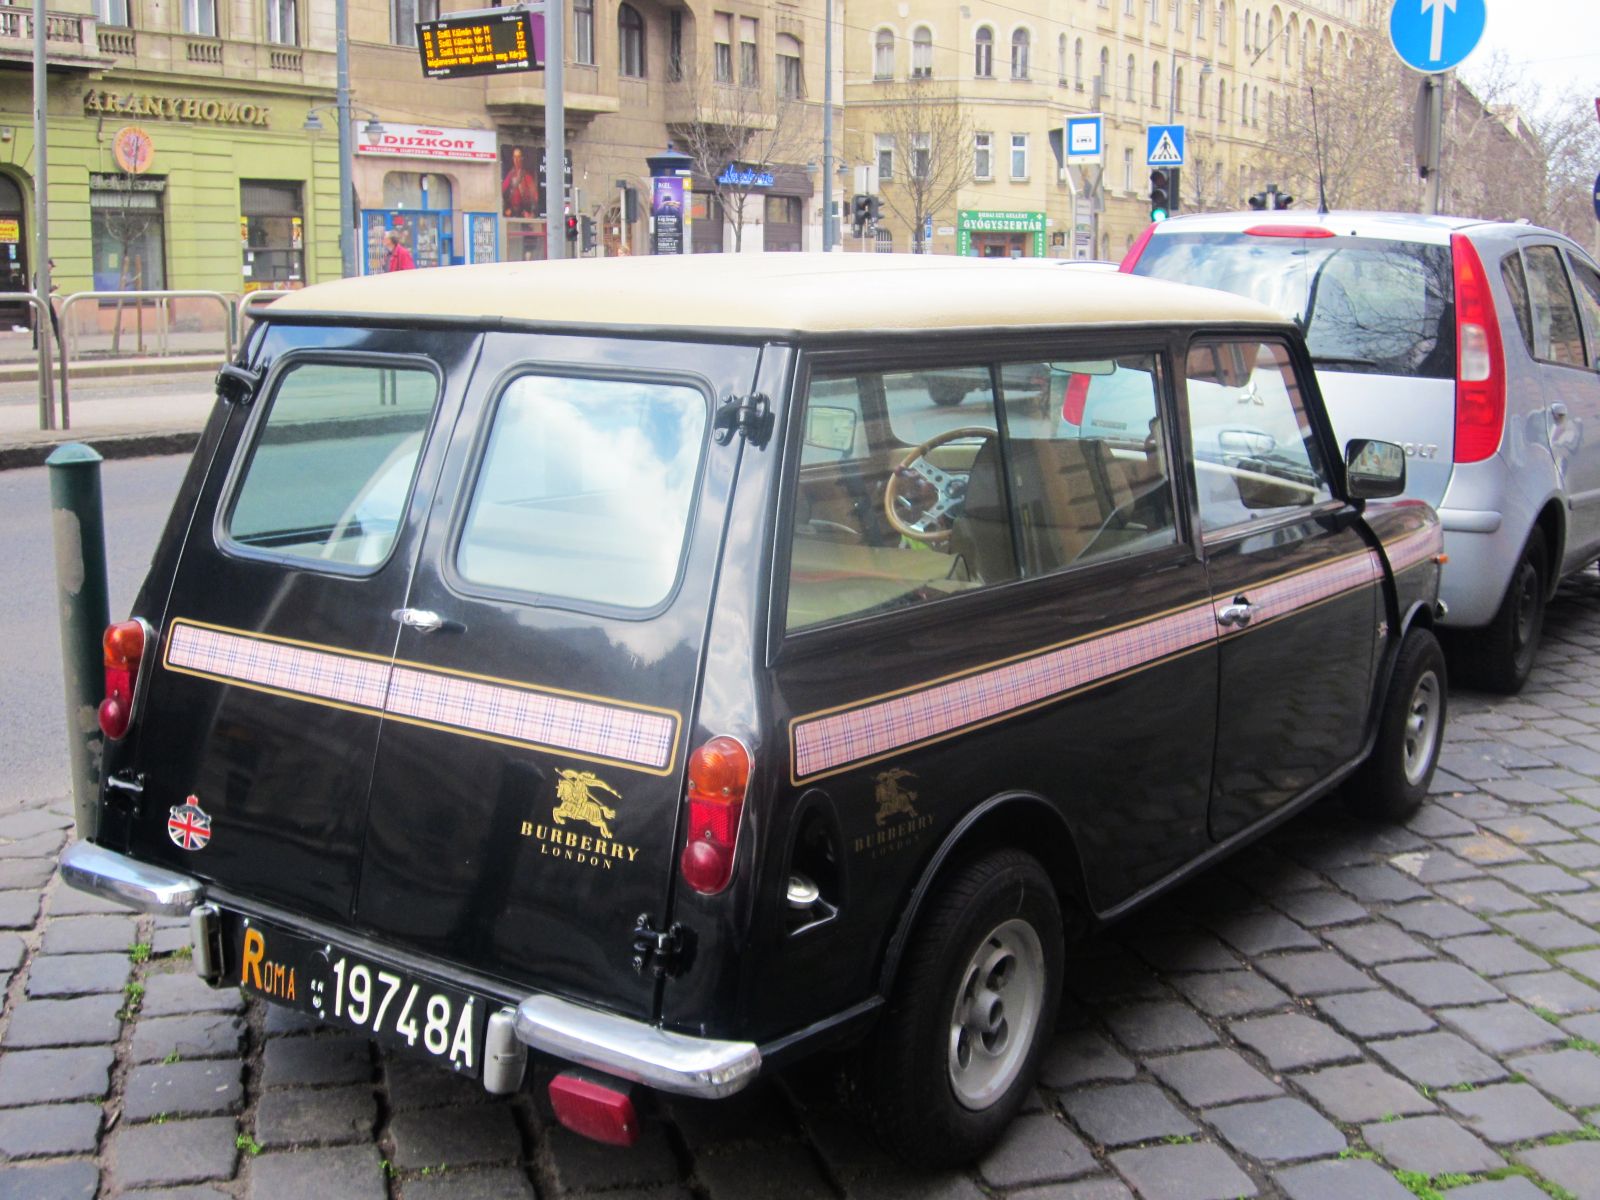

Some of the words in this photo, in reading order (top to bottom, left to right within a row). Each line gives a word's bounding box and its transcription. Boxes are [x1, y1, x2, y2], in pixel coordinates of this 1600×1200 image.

[85, 90, 272, 127] ARANYHOMOK
[384, 135, 475, 149] DISZKONT
[963, 217, 1042, 231] GYÓGYSZERTÁR
[1396, 441, 1438, 459] OLT
[520, 820, 640, 862] BURBERRY
[541, 843, 612, 870] LONDON
[241, 927, 296, 1001] ROMA
[333, 957, 474, 1069] 19748A
